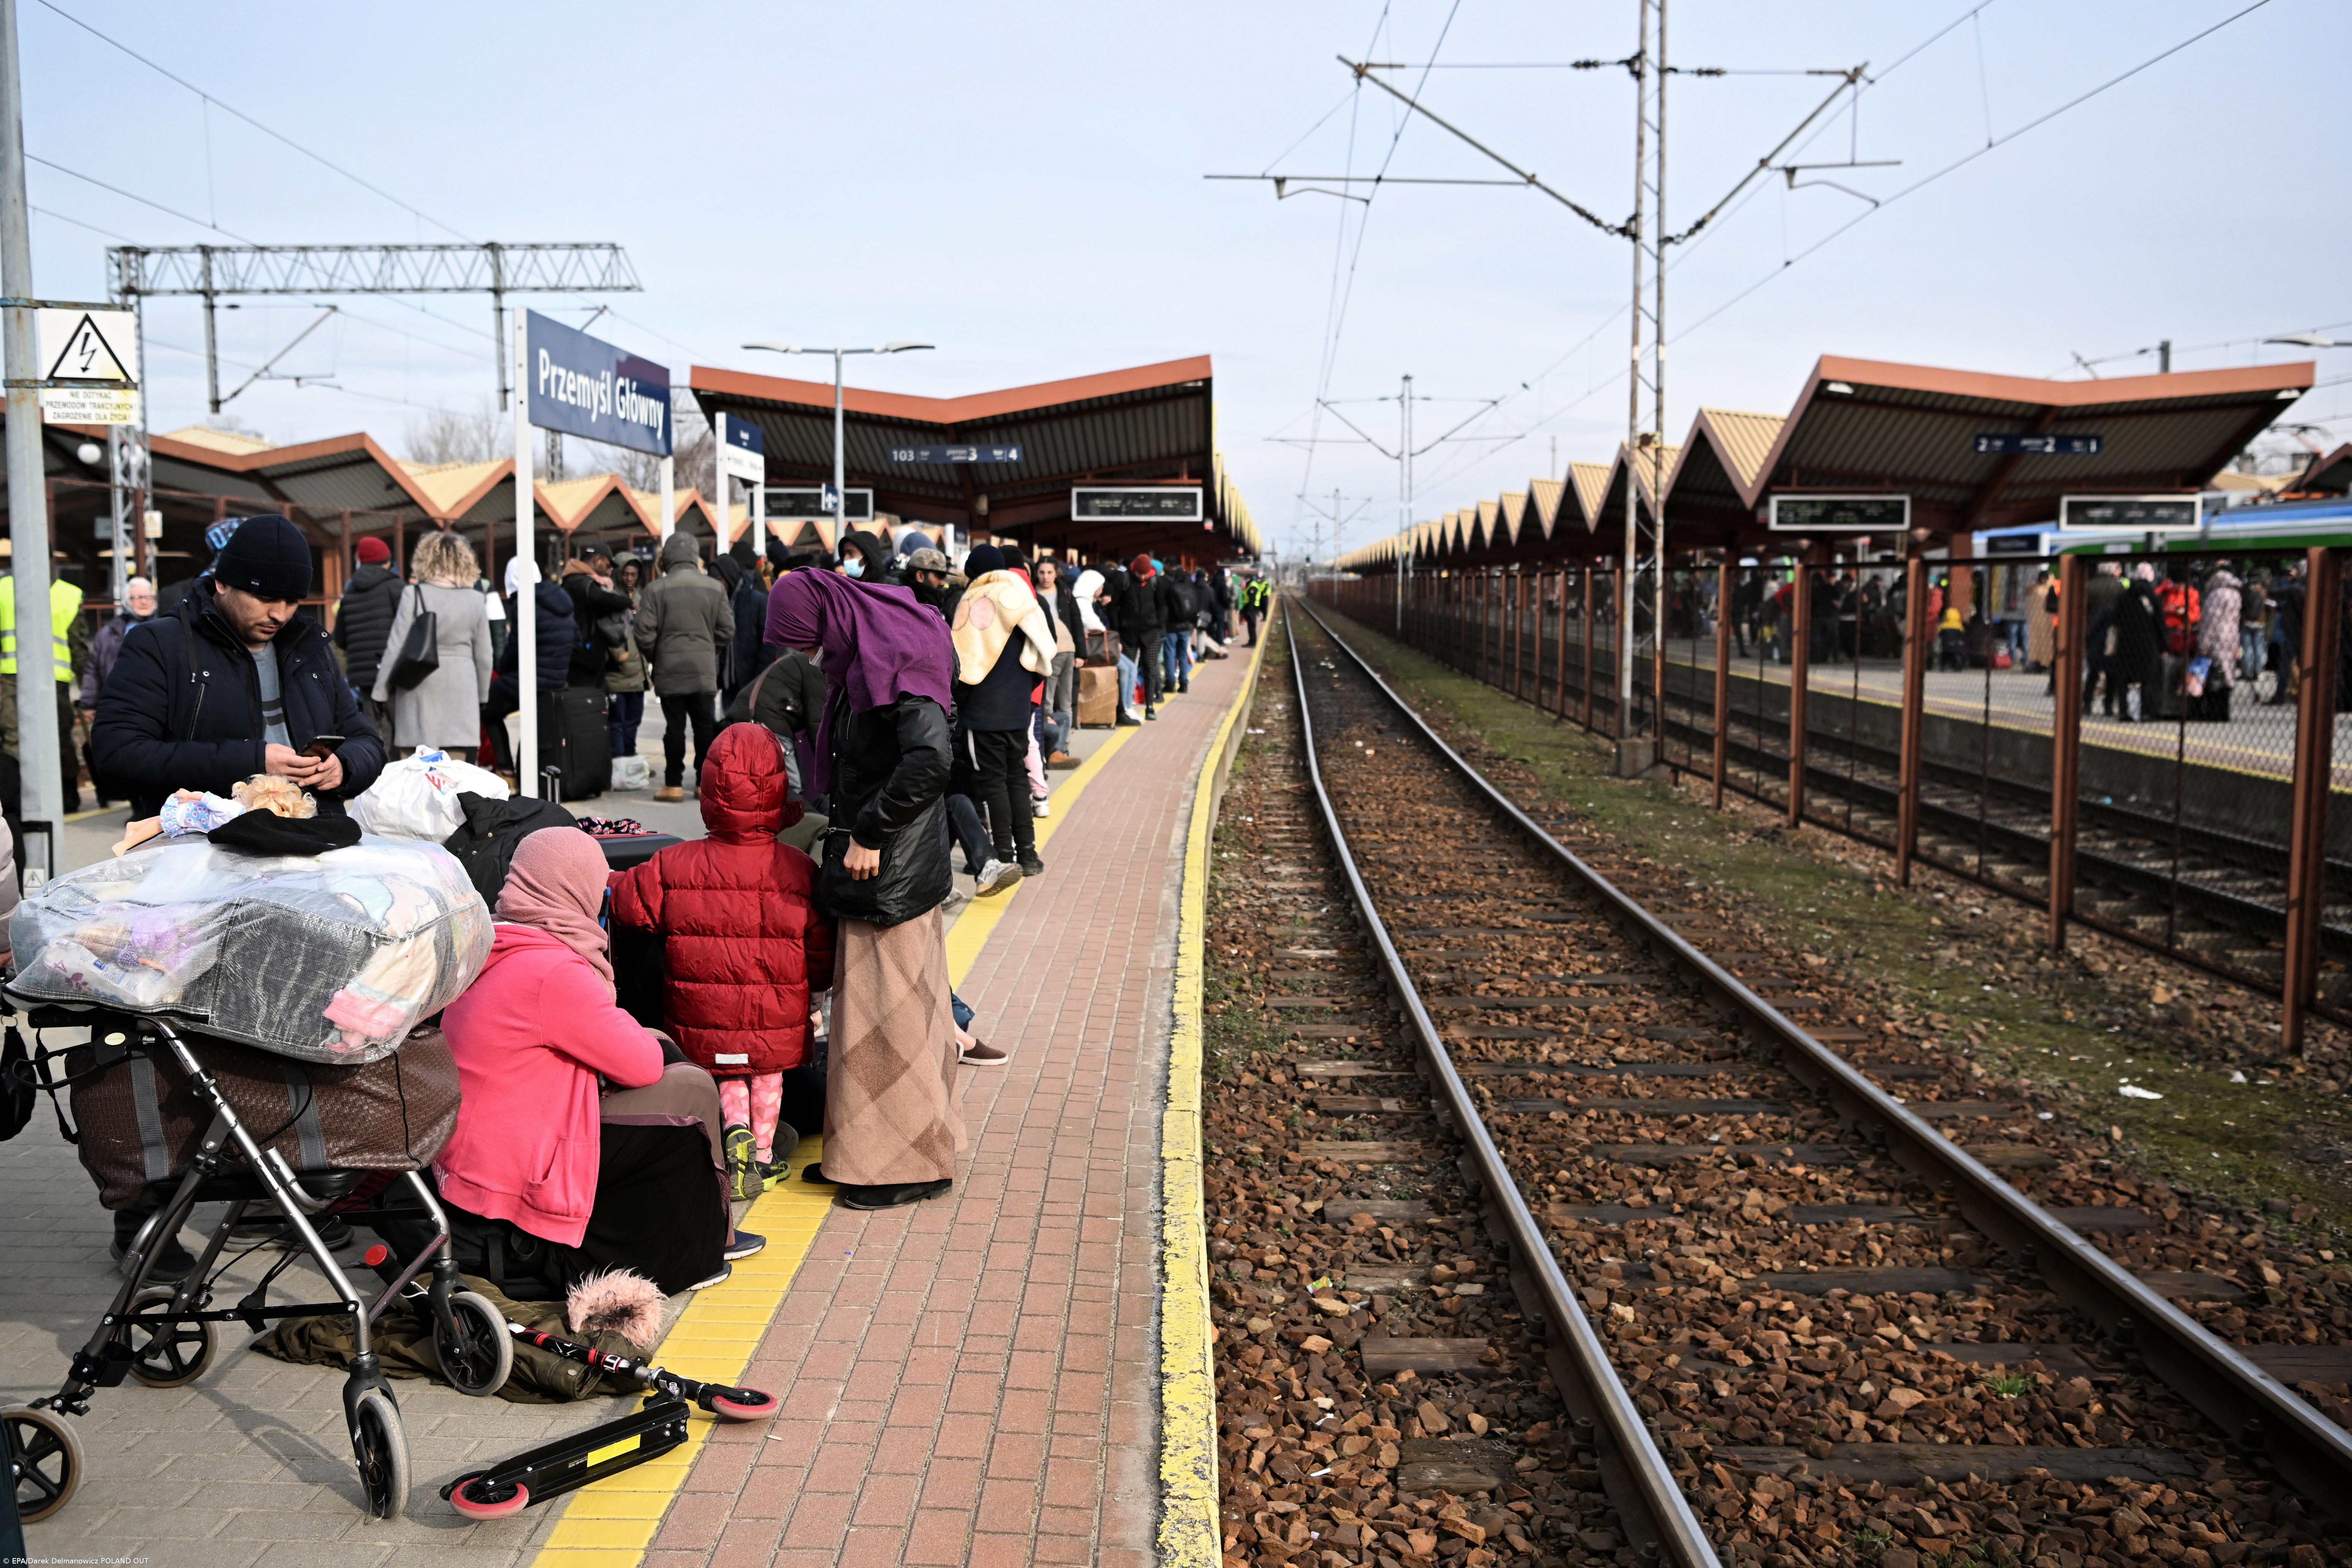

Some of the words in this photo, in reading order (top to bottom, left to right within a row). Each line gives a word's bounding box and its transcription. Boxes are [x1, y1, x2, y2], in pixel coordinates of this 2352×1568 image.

[539, 348, 611, 423] Przemyśl
[615, 376, 664, 440] Główny
[1977, 437, 1988, 451] 2
[2044, 436, 2056, 452] 2
[893, 449, 914, 462] 103
[969, 446, 977, 461] 3
[1008, 447, 1018, 460] 4
